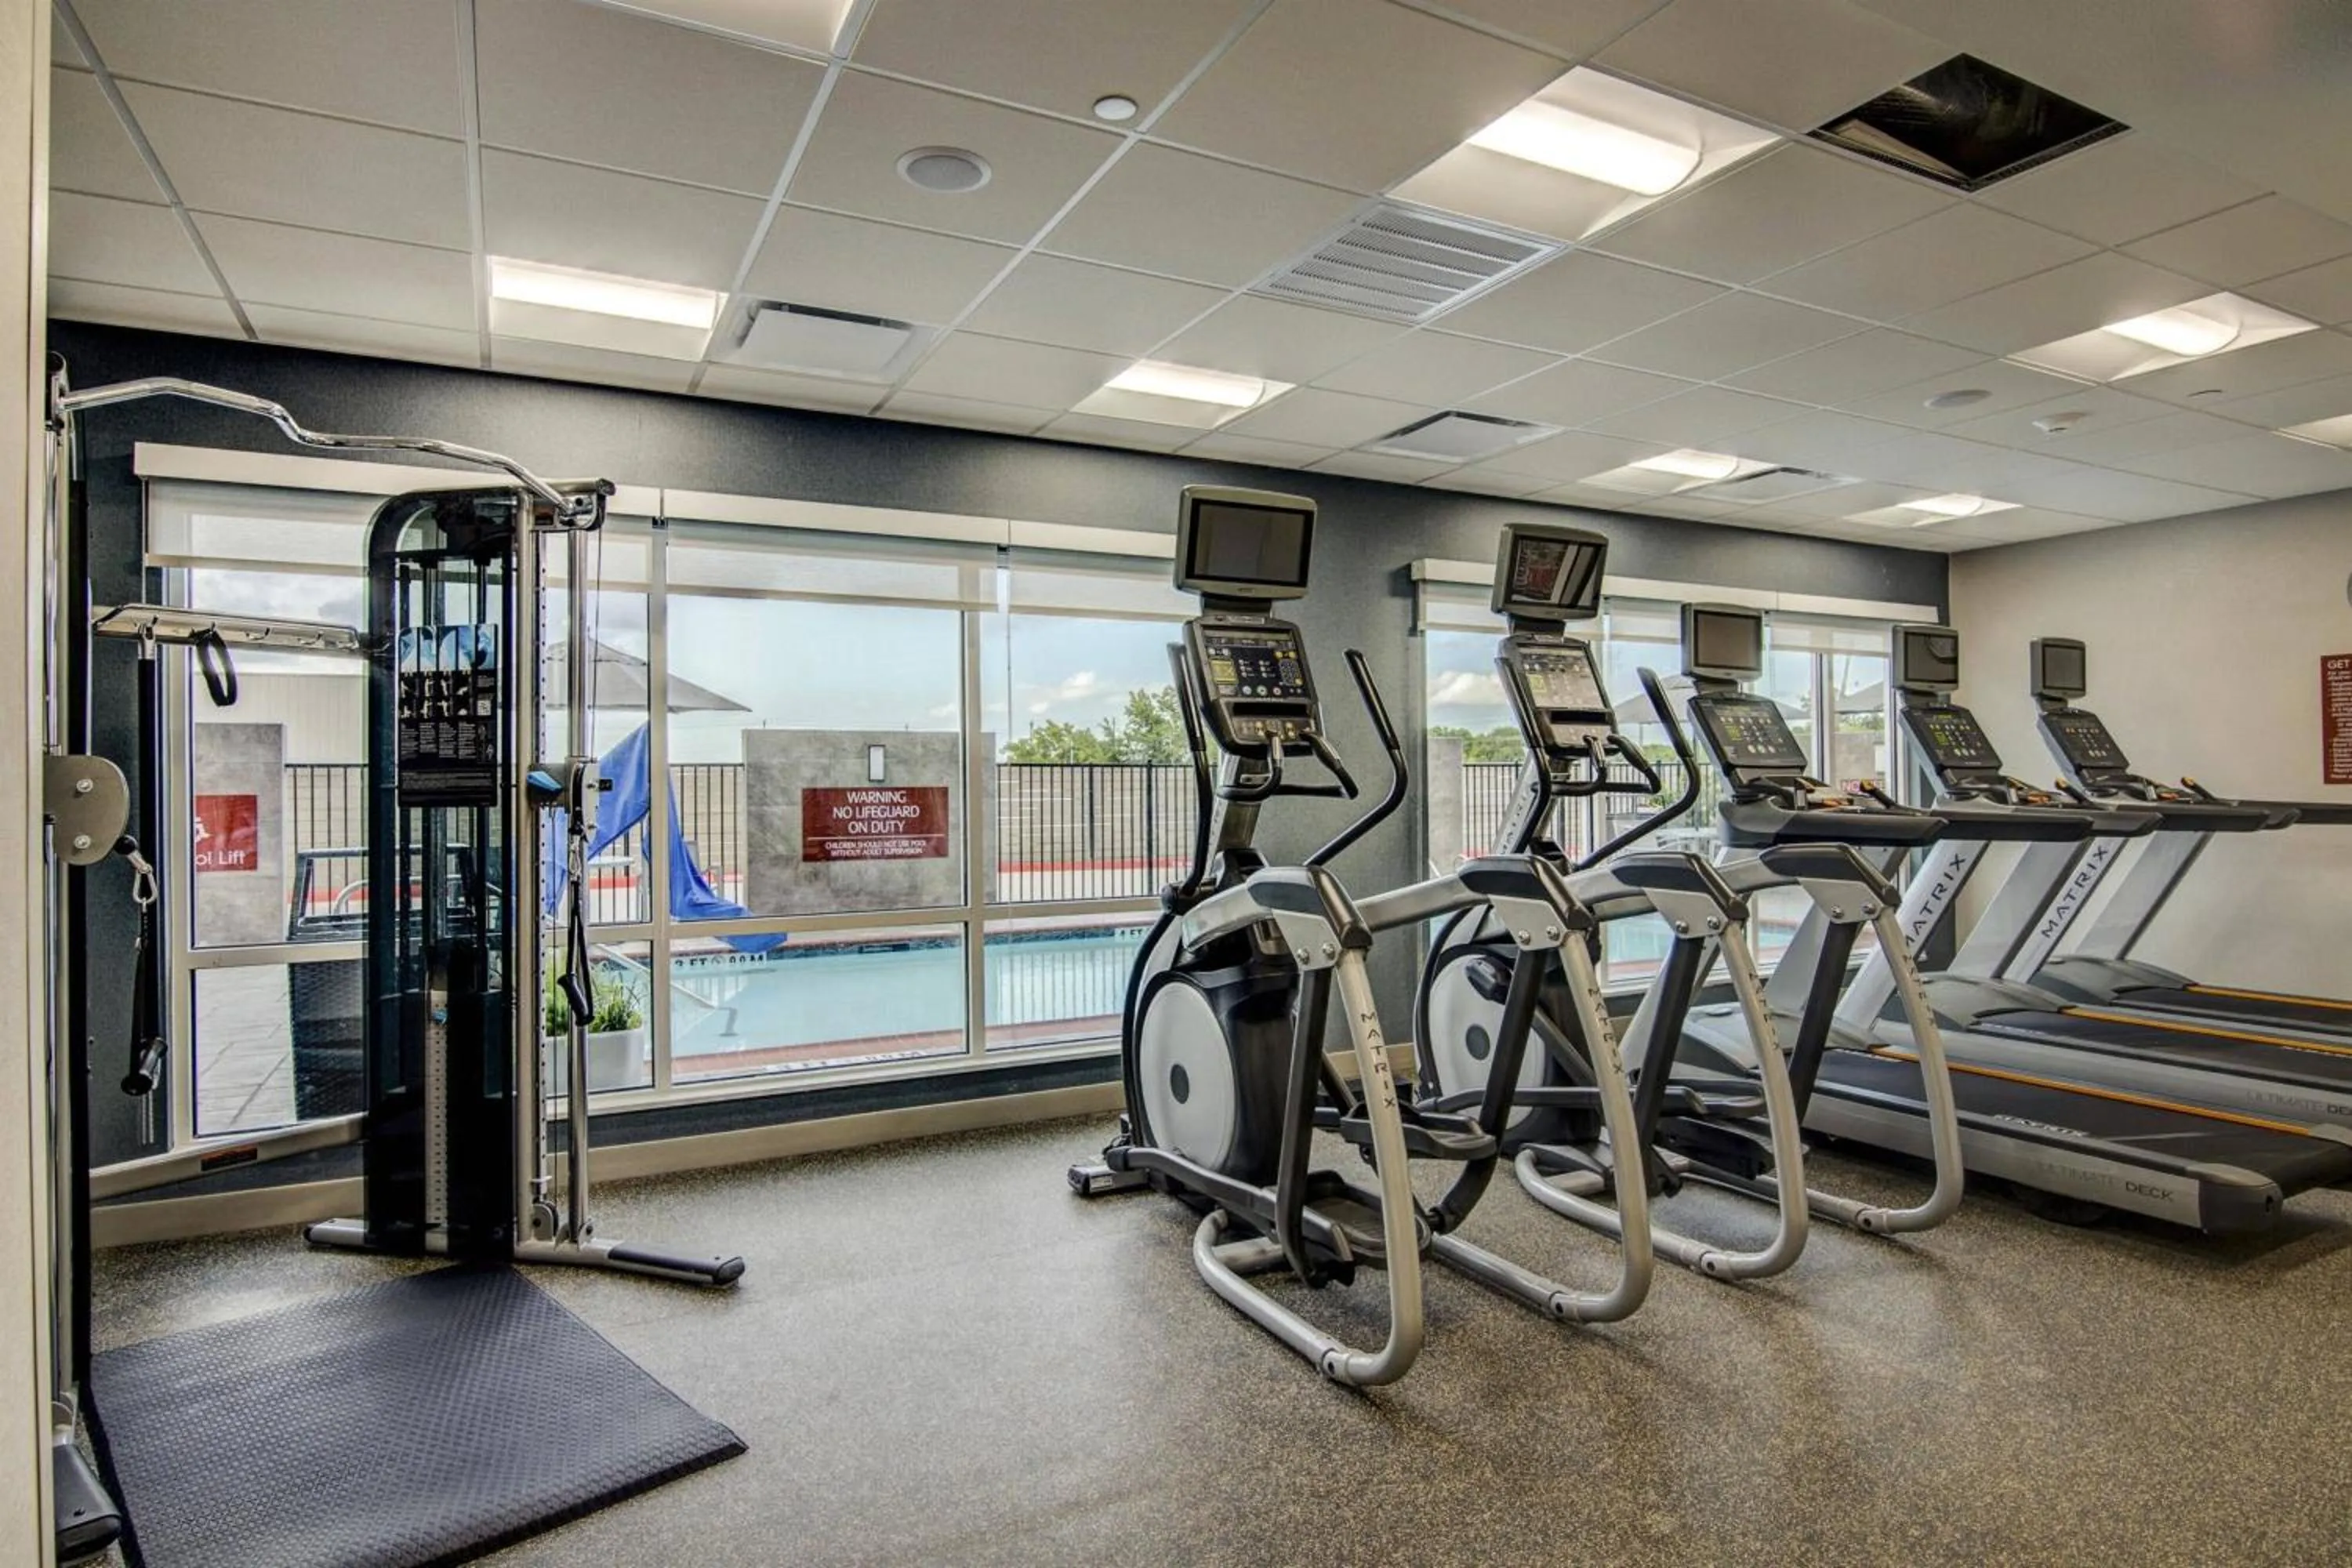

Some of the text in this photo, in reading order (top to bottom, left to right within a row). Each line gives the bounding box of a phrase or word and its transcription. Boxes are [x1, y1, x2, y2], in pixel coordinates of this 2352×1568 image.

[847, 790, 906, 804] WARNING
[833, 805, 920, 819] NO LIFEGUARD
[848, 820, 906, 833] ON DUTY
[196, 850, 245, 866] ol Lift
[2041, 846, 2107, 938] MATRIX
[1361, 1011, 1396, 1108] MATRIX
[2125, 1181, 2173, 1202] DECK
